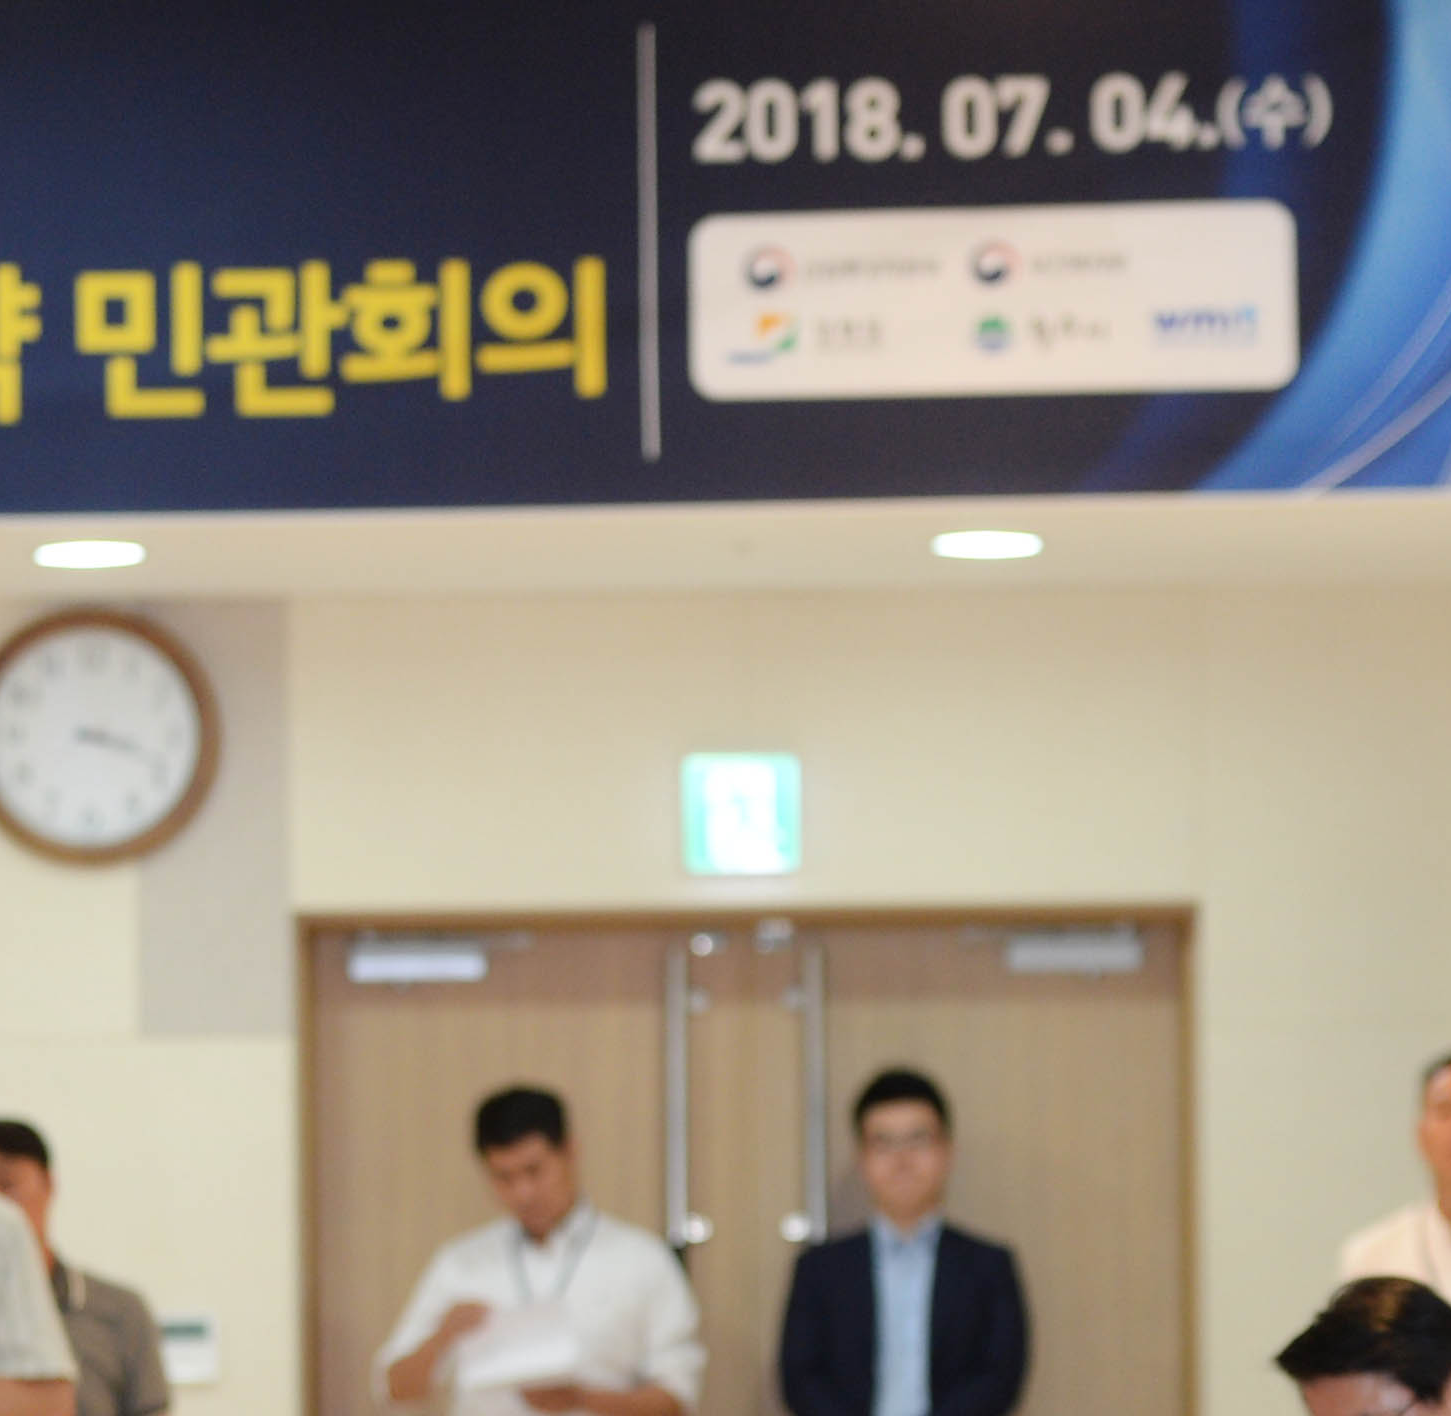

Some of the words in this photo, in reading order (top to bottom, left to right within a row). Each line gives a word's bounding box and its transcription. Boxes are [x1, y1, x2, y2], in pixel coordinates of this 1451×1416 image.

[692, 76, 926, 164] 2018.
[941, 74, 1074, 160] 07.
[73, 255, 608, 420] 민관회의
